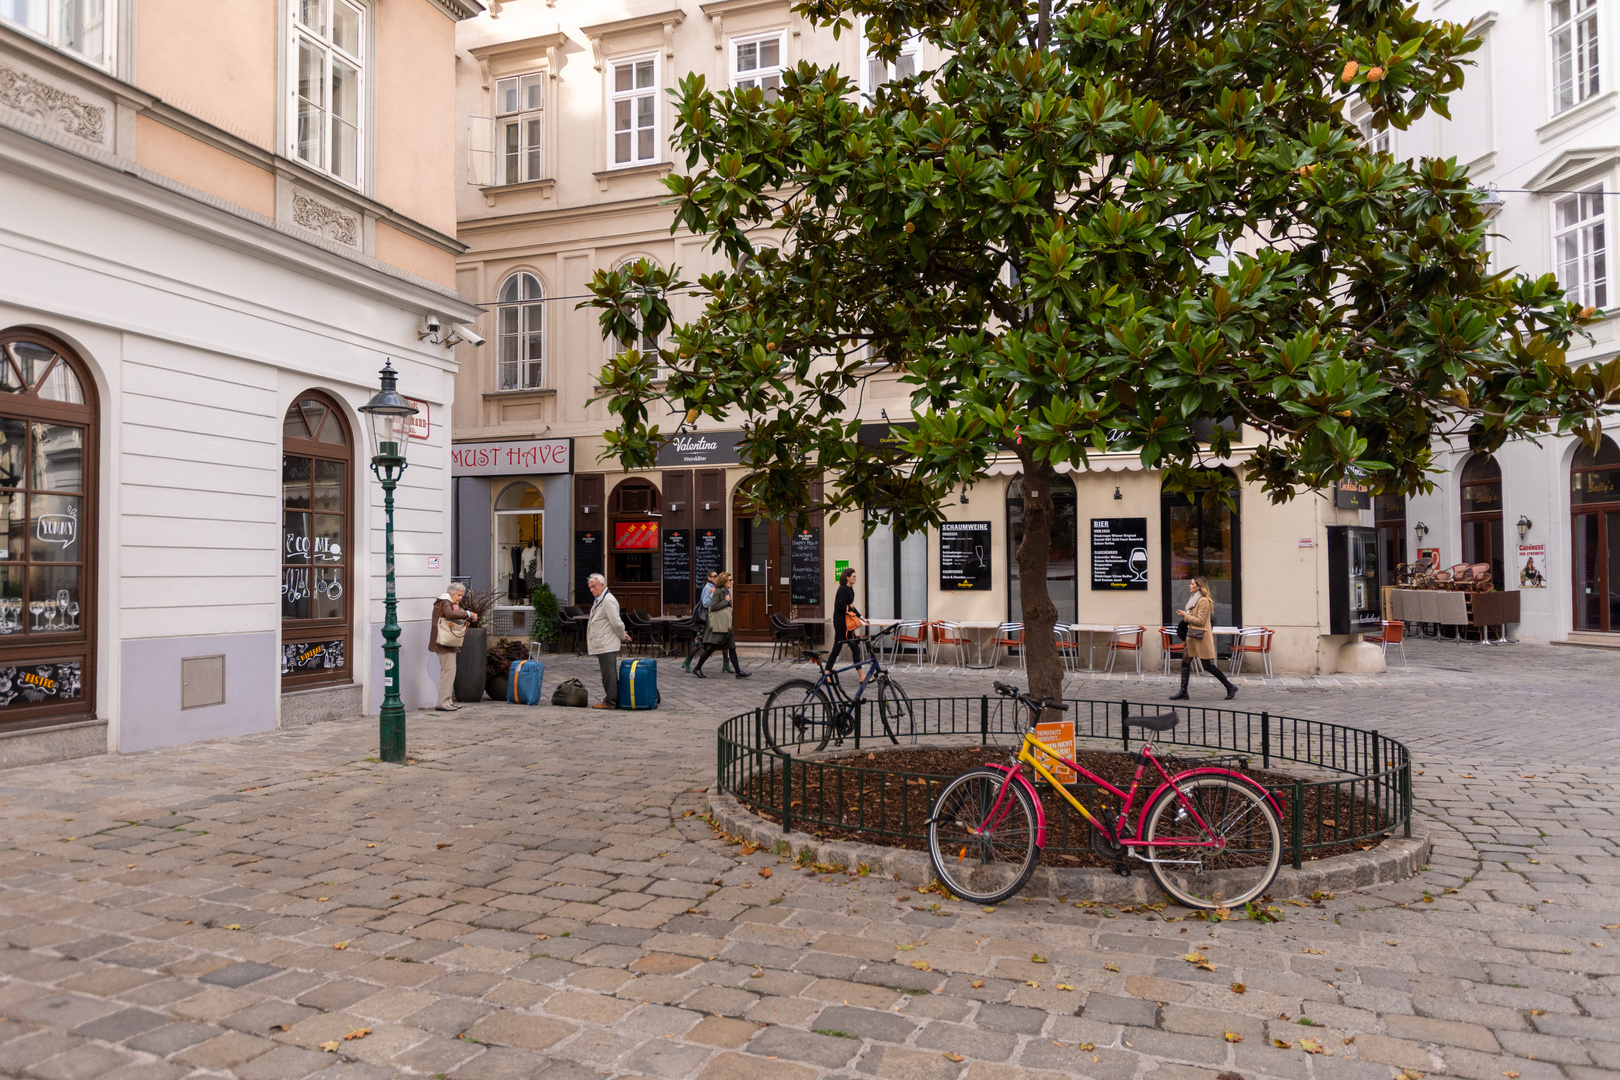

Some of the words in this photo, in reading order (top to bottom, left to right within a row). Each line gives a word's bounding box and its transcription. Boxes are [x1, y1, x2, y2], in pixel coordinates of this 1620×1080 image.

[672, 436, 718, 452] Valentina
[451, 447, 502, 467] MUST
[507, 444, 567, 468] HAVE
[1587, 480, 1614, 494] Sally's
[41, 520, 75, 535] YUMMY
[942, 523, 988, 531] SCHAUMWEINE
[24, 672, 55, 689] BISTRO
[1057, 740, 1073, 749] NICHT
